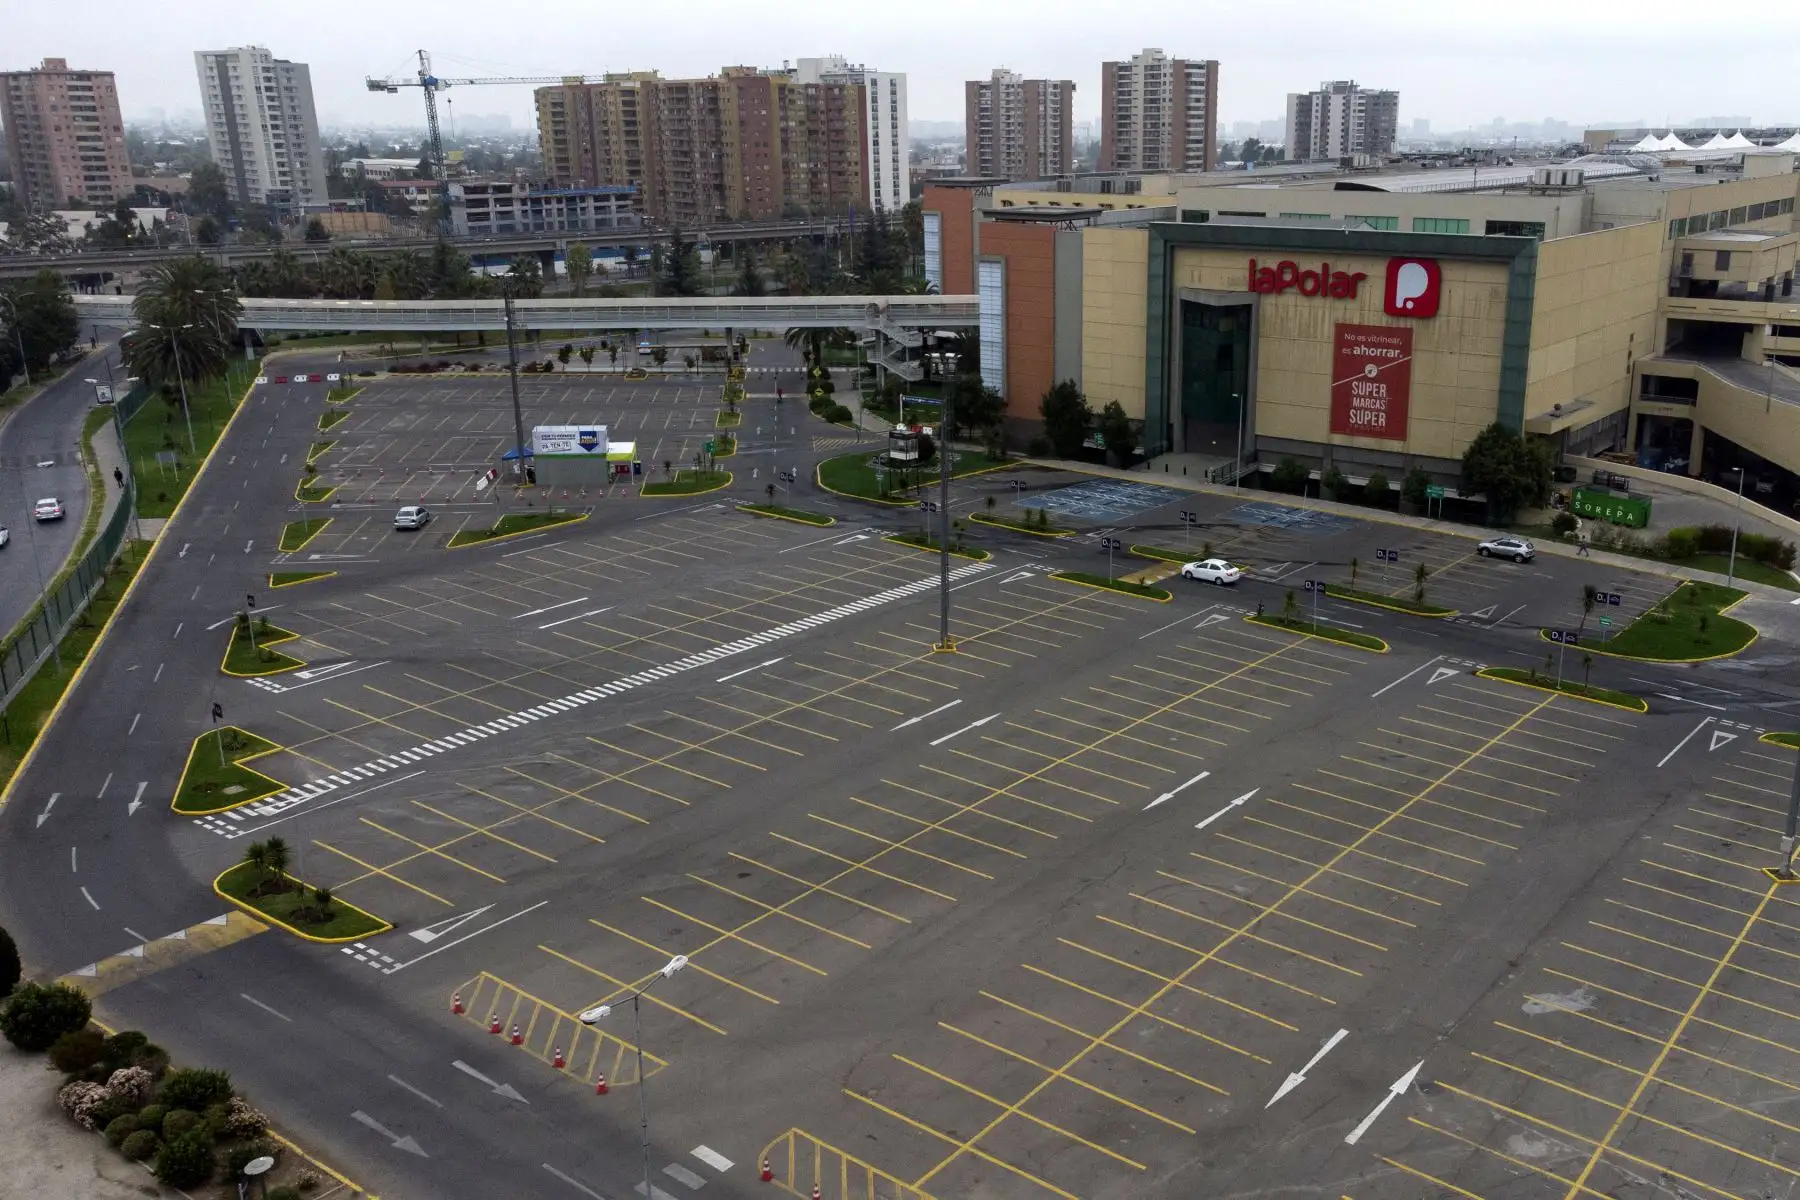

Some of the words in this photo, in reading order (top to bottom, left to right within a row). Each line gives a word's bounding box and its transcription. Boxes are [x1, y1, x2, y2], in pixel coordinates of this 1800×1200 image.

[1248, 258, 1367, 300] laPolar
[1344, 332, 1355, 341] No
[1353, 344, 1402, 358] ahorrar.
[1352, 381, 1387, 398] SUPER
[1352, 397, 1386, 410] MARCAS
[1349, 409, 1386, 427] SUPER
[1575, 501, 1633, 520] SOREPA
